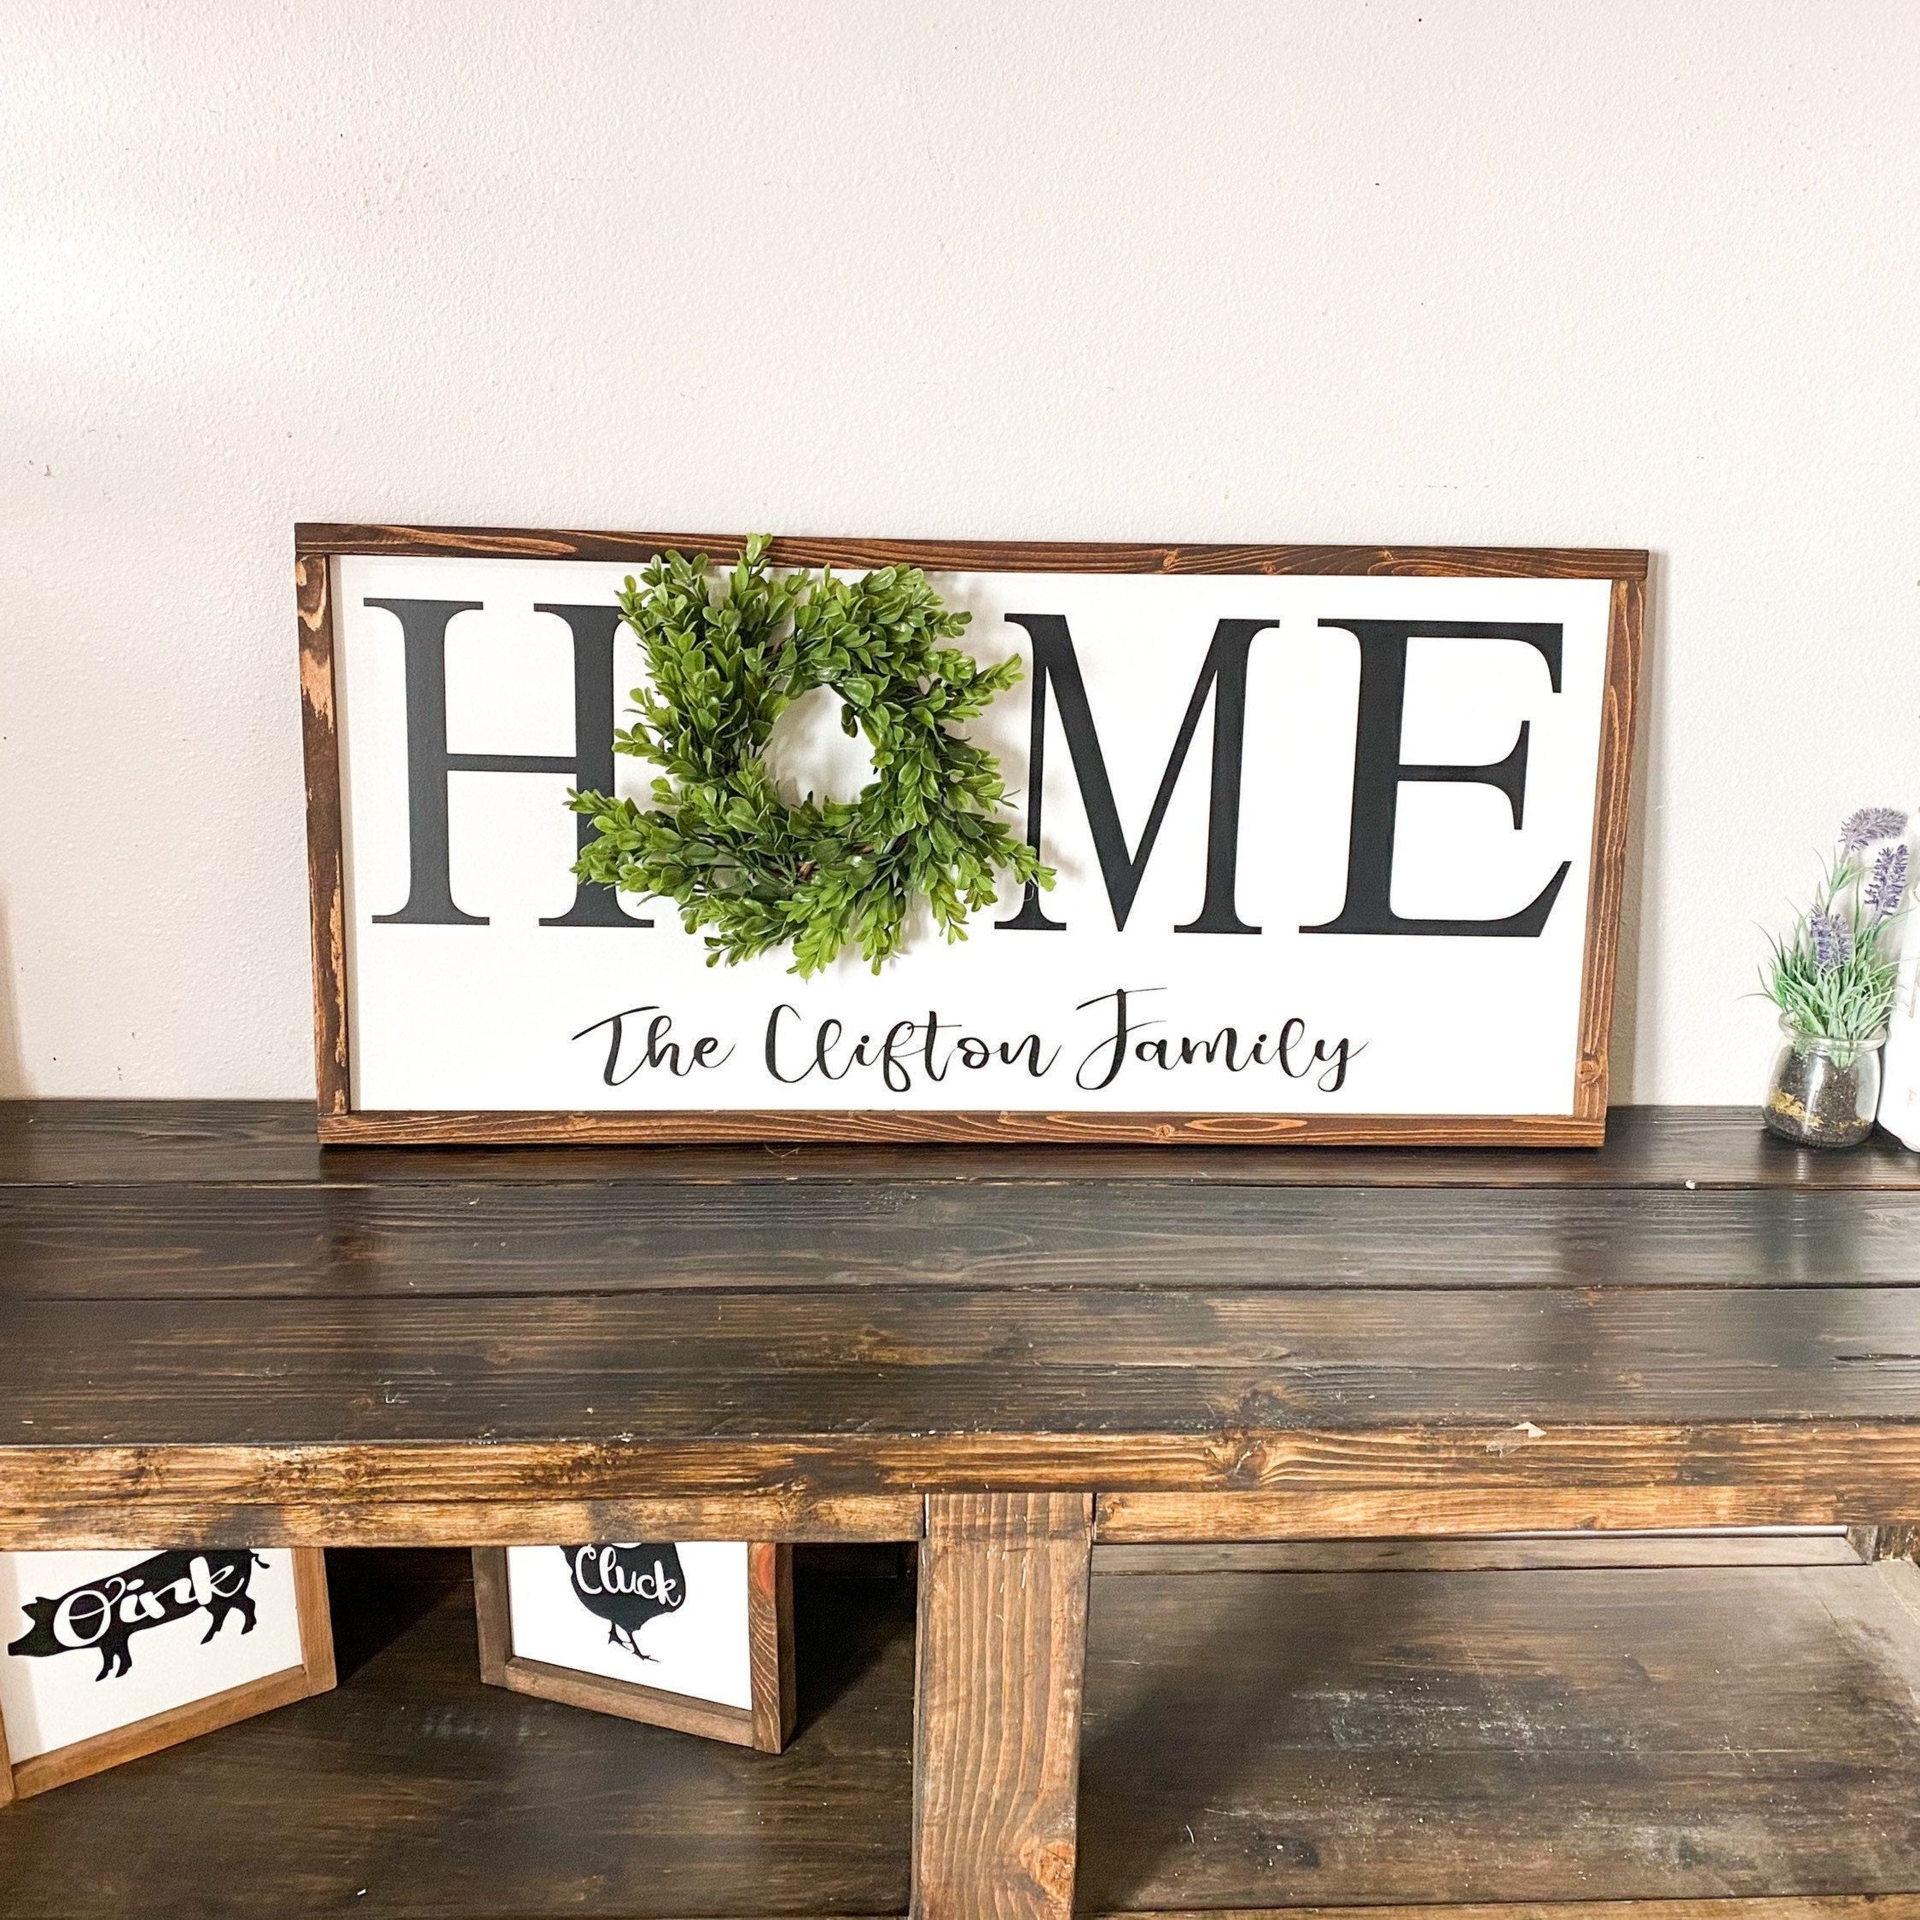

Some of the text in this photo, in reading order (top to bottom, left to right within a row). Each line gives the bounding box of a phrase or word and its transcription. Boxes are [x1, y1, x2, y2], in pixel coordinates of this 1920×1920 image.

[572, 986, 1371, 1093] The Clifton Family
[53, 1556, 245, 1648] Oink
[575, 1544, 682, 1606] Cluck
